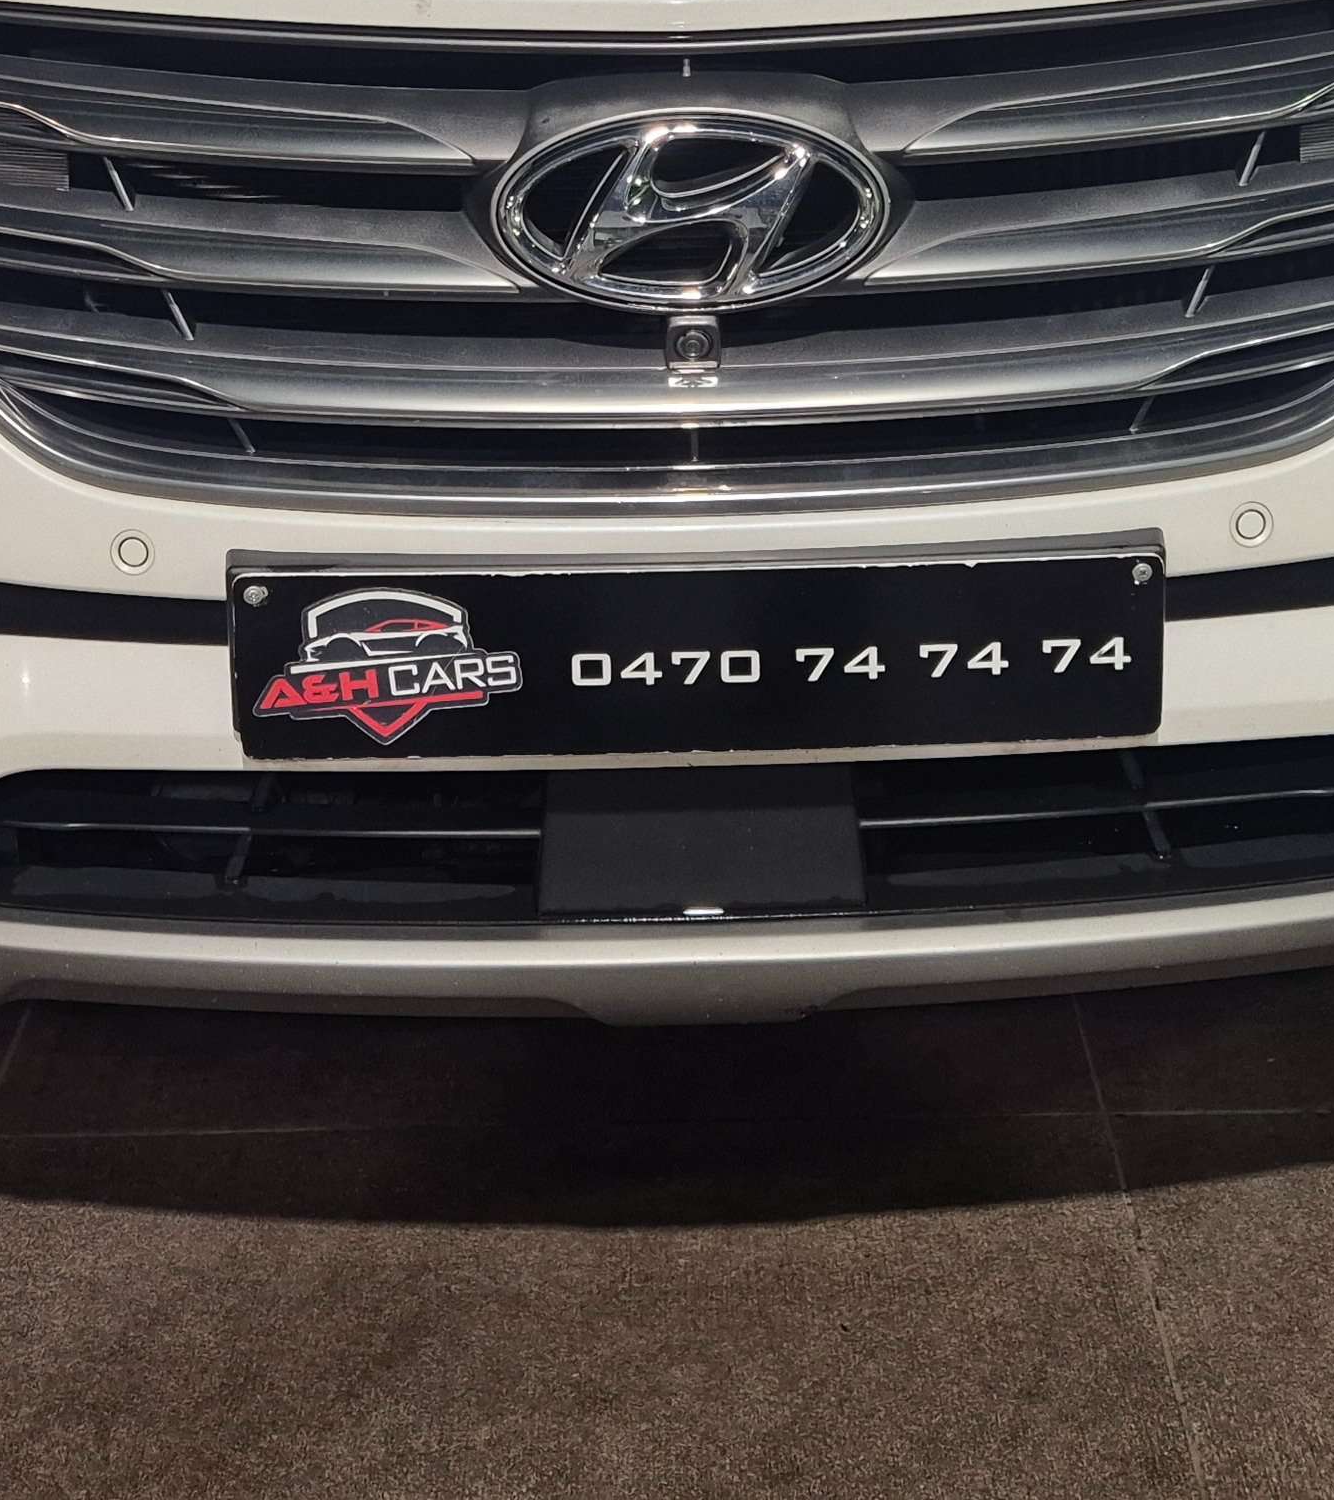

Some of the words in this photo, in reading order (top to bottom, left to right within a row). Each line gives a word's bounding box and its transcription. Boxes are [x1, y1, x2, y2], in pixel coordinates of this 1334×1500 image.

[260, 668, 380, 709] A&H
[387, 653, 518, 697] CARS
[570, 649, 761, 687] 0470
[794, 646, 887, 682] 74
[918, 641, 1010, 678] 74
[1041, 636, 1133, 674] 74
